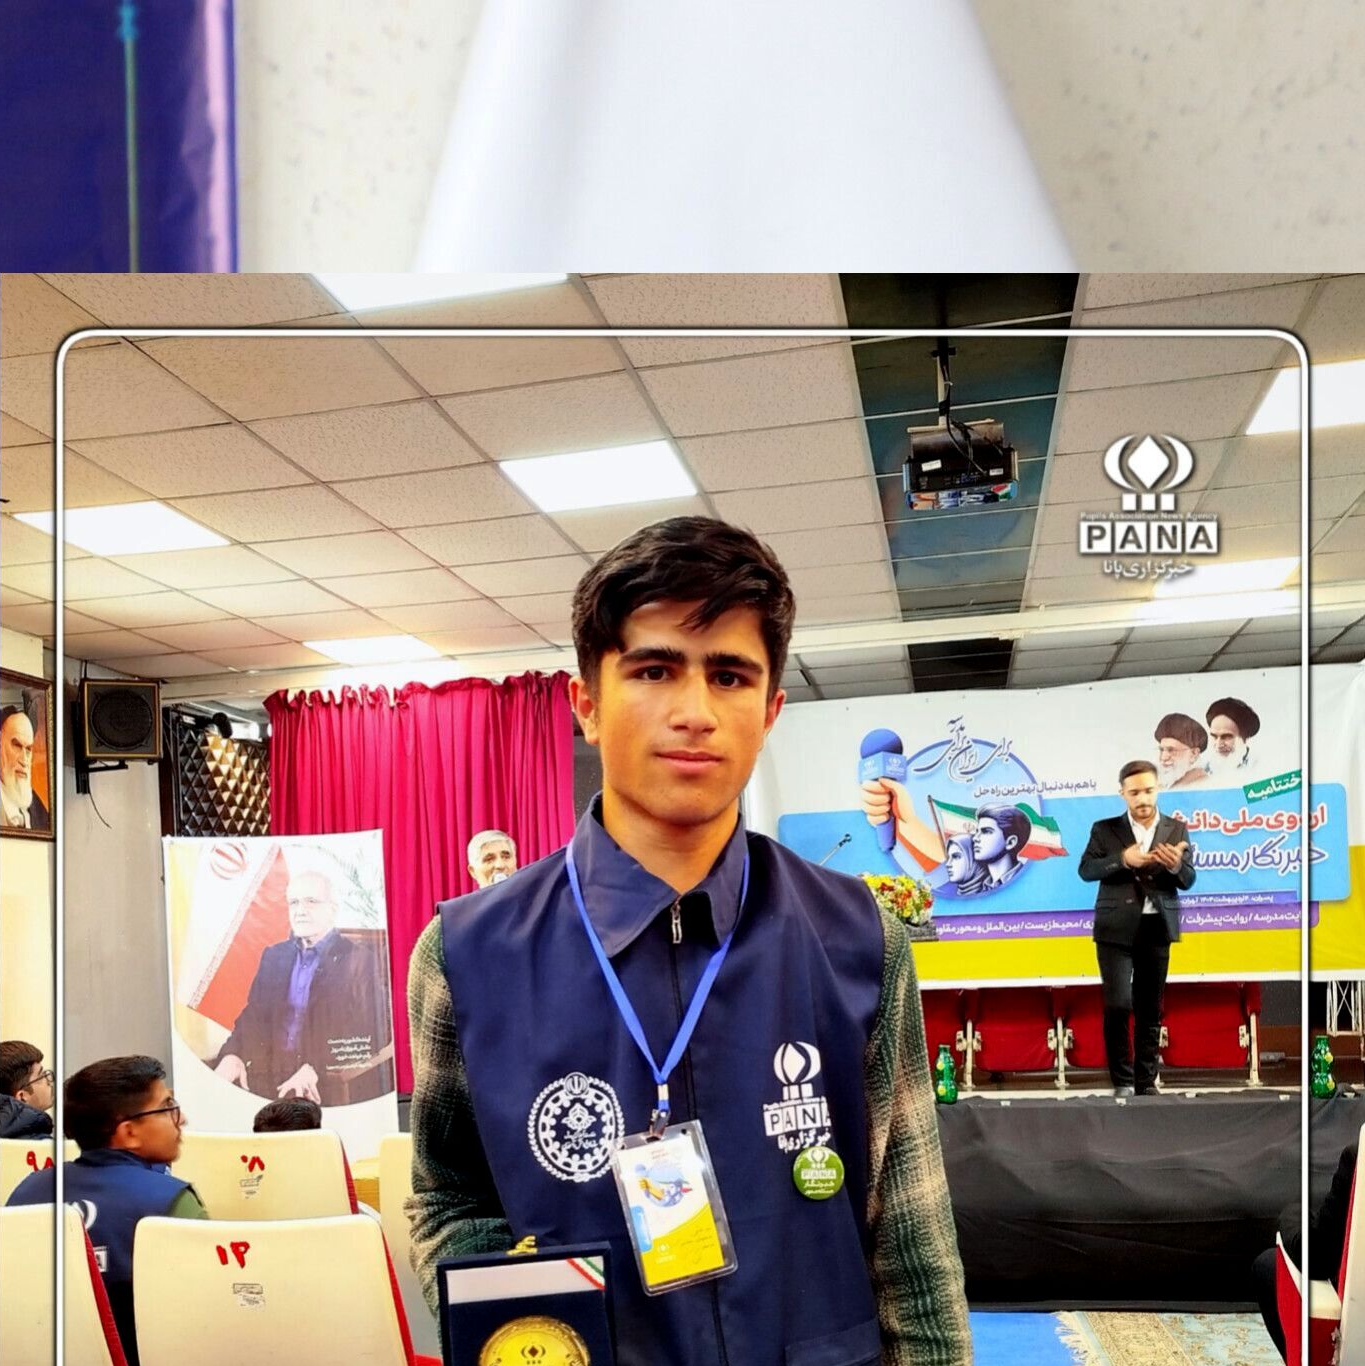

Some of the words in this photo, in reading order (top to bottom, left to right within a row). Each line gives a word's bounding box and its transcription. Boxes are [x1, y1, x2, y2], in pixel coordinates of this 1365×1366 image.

[1247, 772, 1302, 800] ختتامیه
[1223, 809, 1263, 833] ملی
[1267, 805, 1327, 830] اروی
